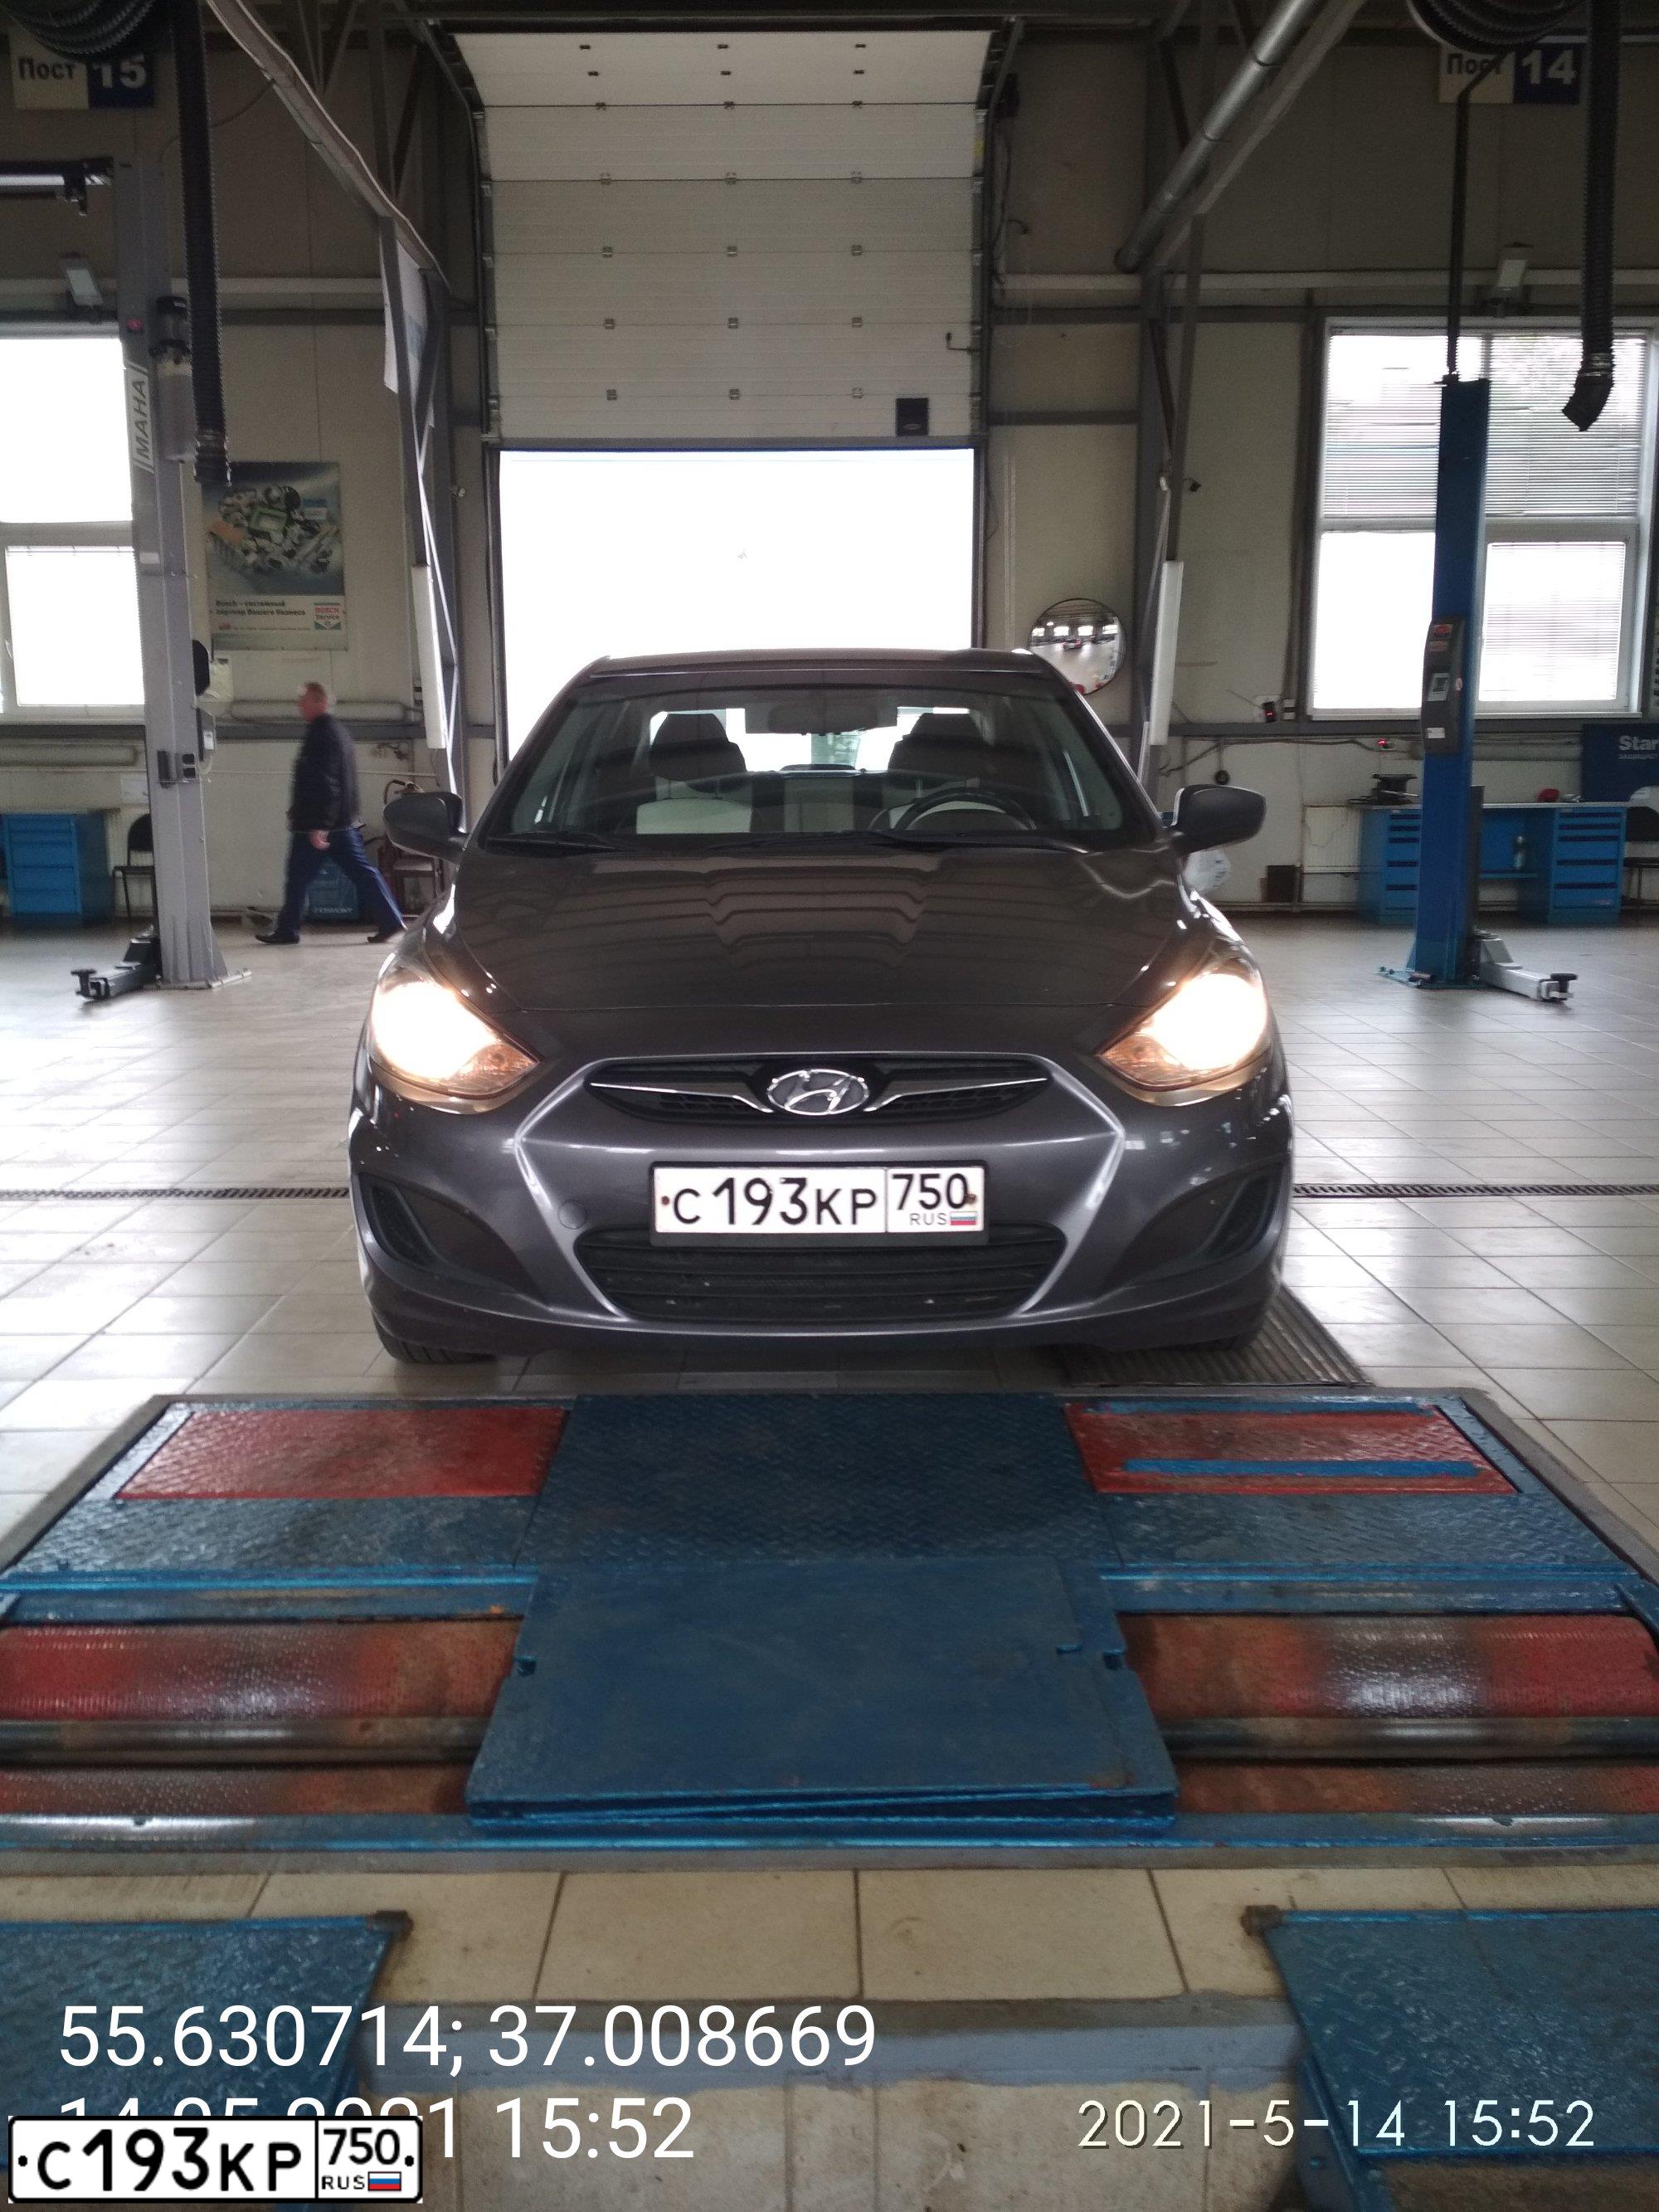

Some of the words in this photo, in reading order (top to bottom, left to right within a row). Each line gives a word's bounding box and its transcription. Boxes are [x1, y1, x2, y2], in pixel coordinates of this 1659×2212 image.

[18, 57, 75, 80] Пост
[93, 53, 147, 89] 15
[1521, 49, 1576, 85] 14
[133, 381, 150, 460] MAHA
[892, 1172, 968, 1211] 750
[910, 1212, 947, 1225] RUS
